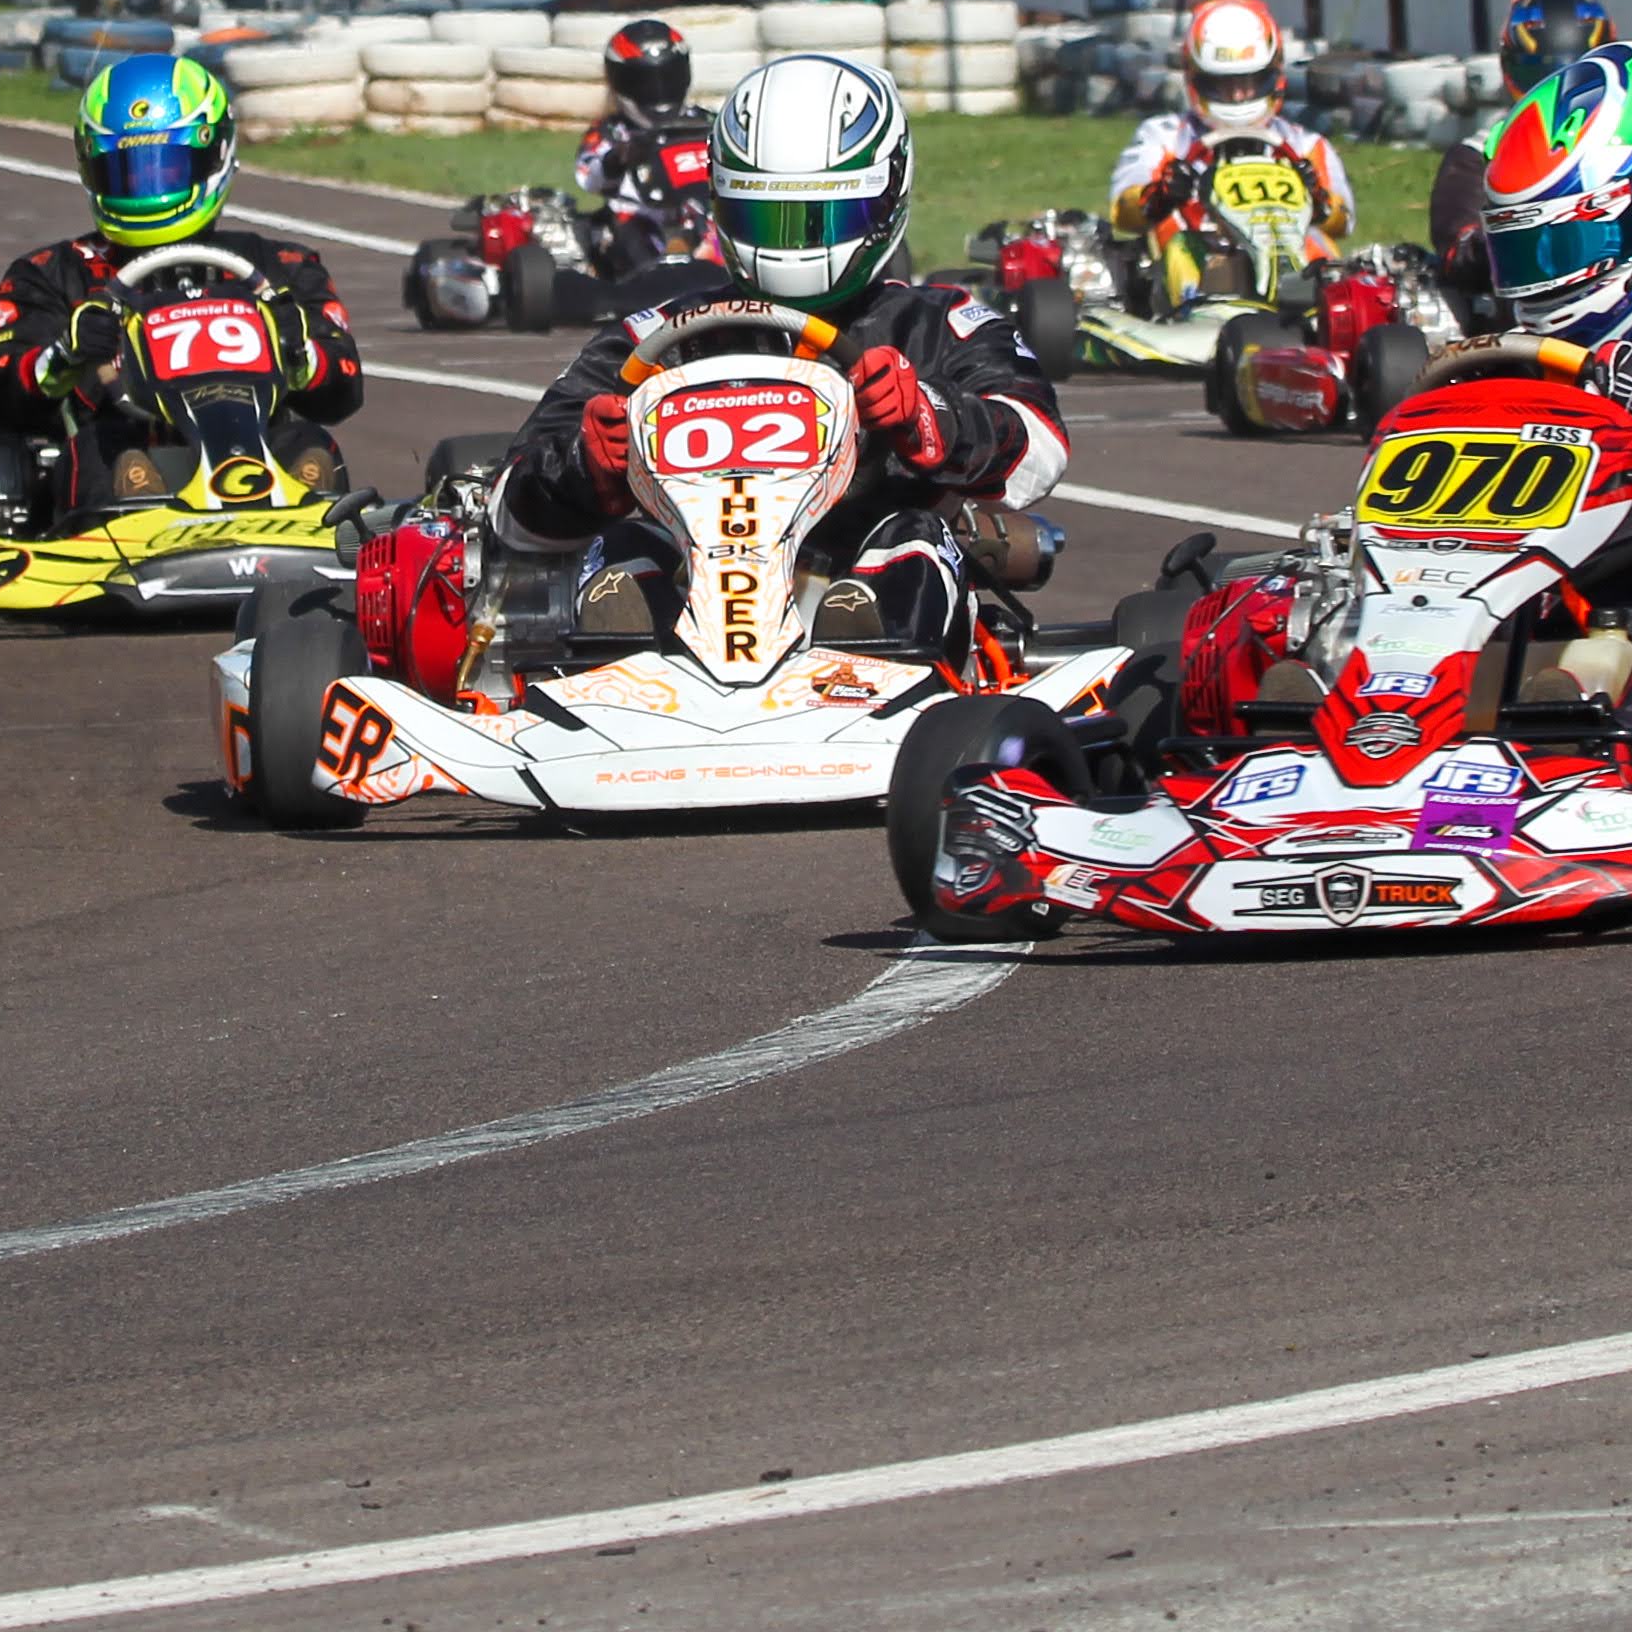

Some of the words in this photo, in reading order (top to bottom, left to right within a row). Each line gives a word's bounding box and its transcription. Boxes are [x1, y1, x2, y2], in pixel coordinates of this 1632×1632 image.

[1228, 181, 1298, 206] 112
[151, 317, 262, 371] 79
[661, 402, 679, 418] B.
[683, 391, 784, 413] Cesconetto
[663, 411, 810, 468] 02
[1530, 425, 1582, 444] F4SS
[1366, 440, 1577, 518] 970
[1360, 675, 1429, 695] JFS
[696, 763, 873, 779] TECHNOLOGY
[1424, 766, 1513, 793] JFS
[1220, 770, 1300, 805] JFS
[1261, 887, 1306, 907] SEG
[1375, 884, 1453, 904] TRUCK
